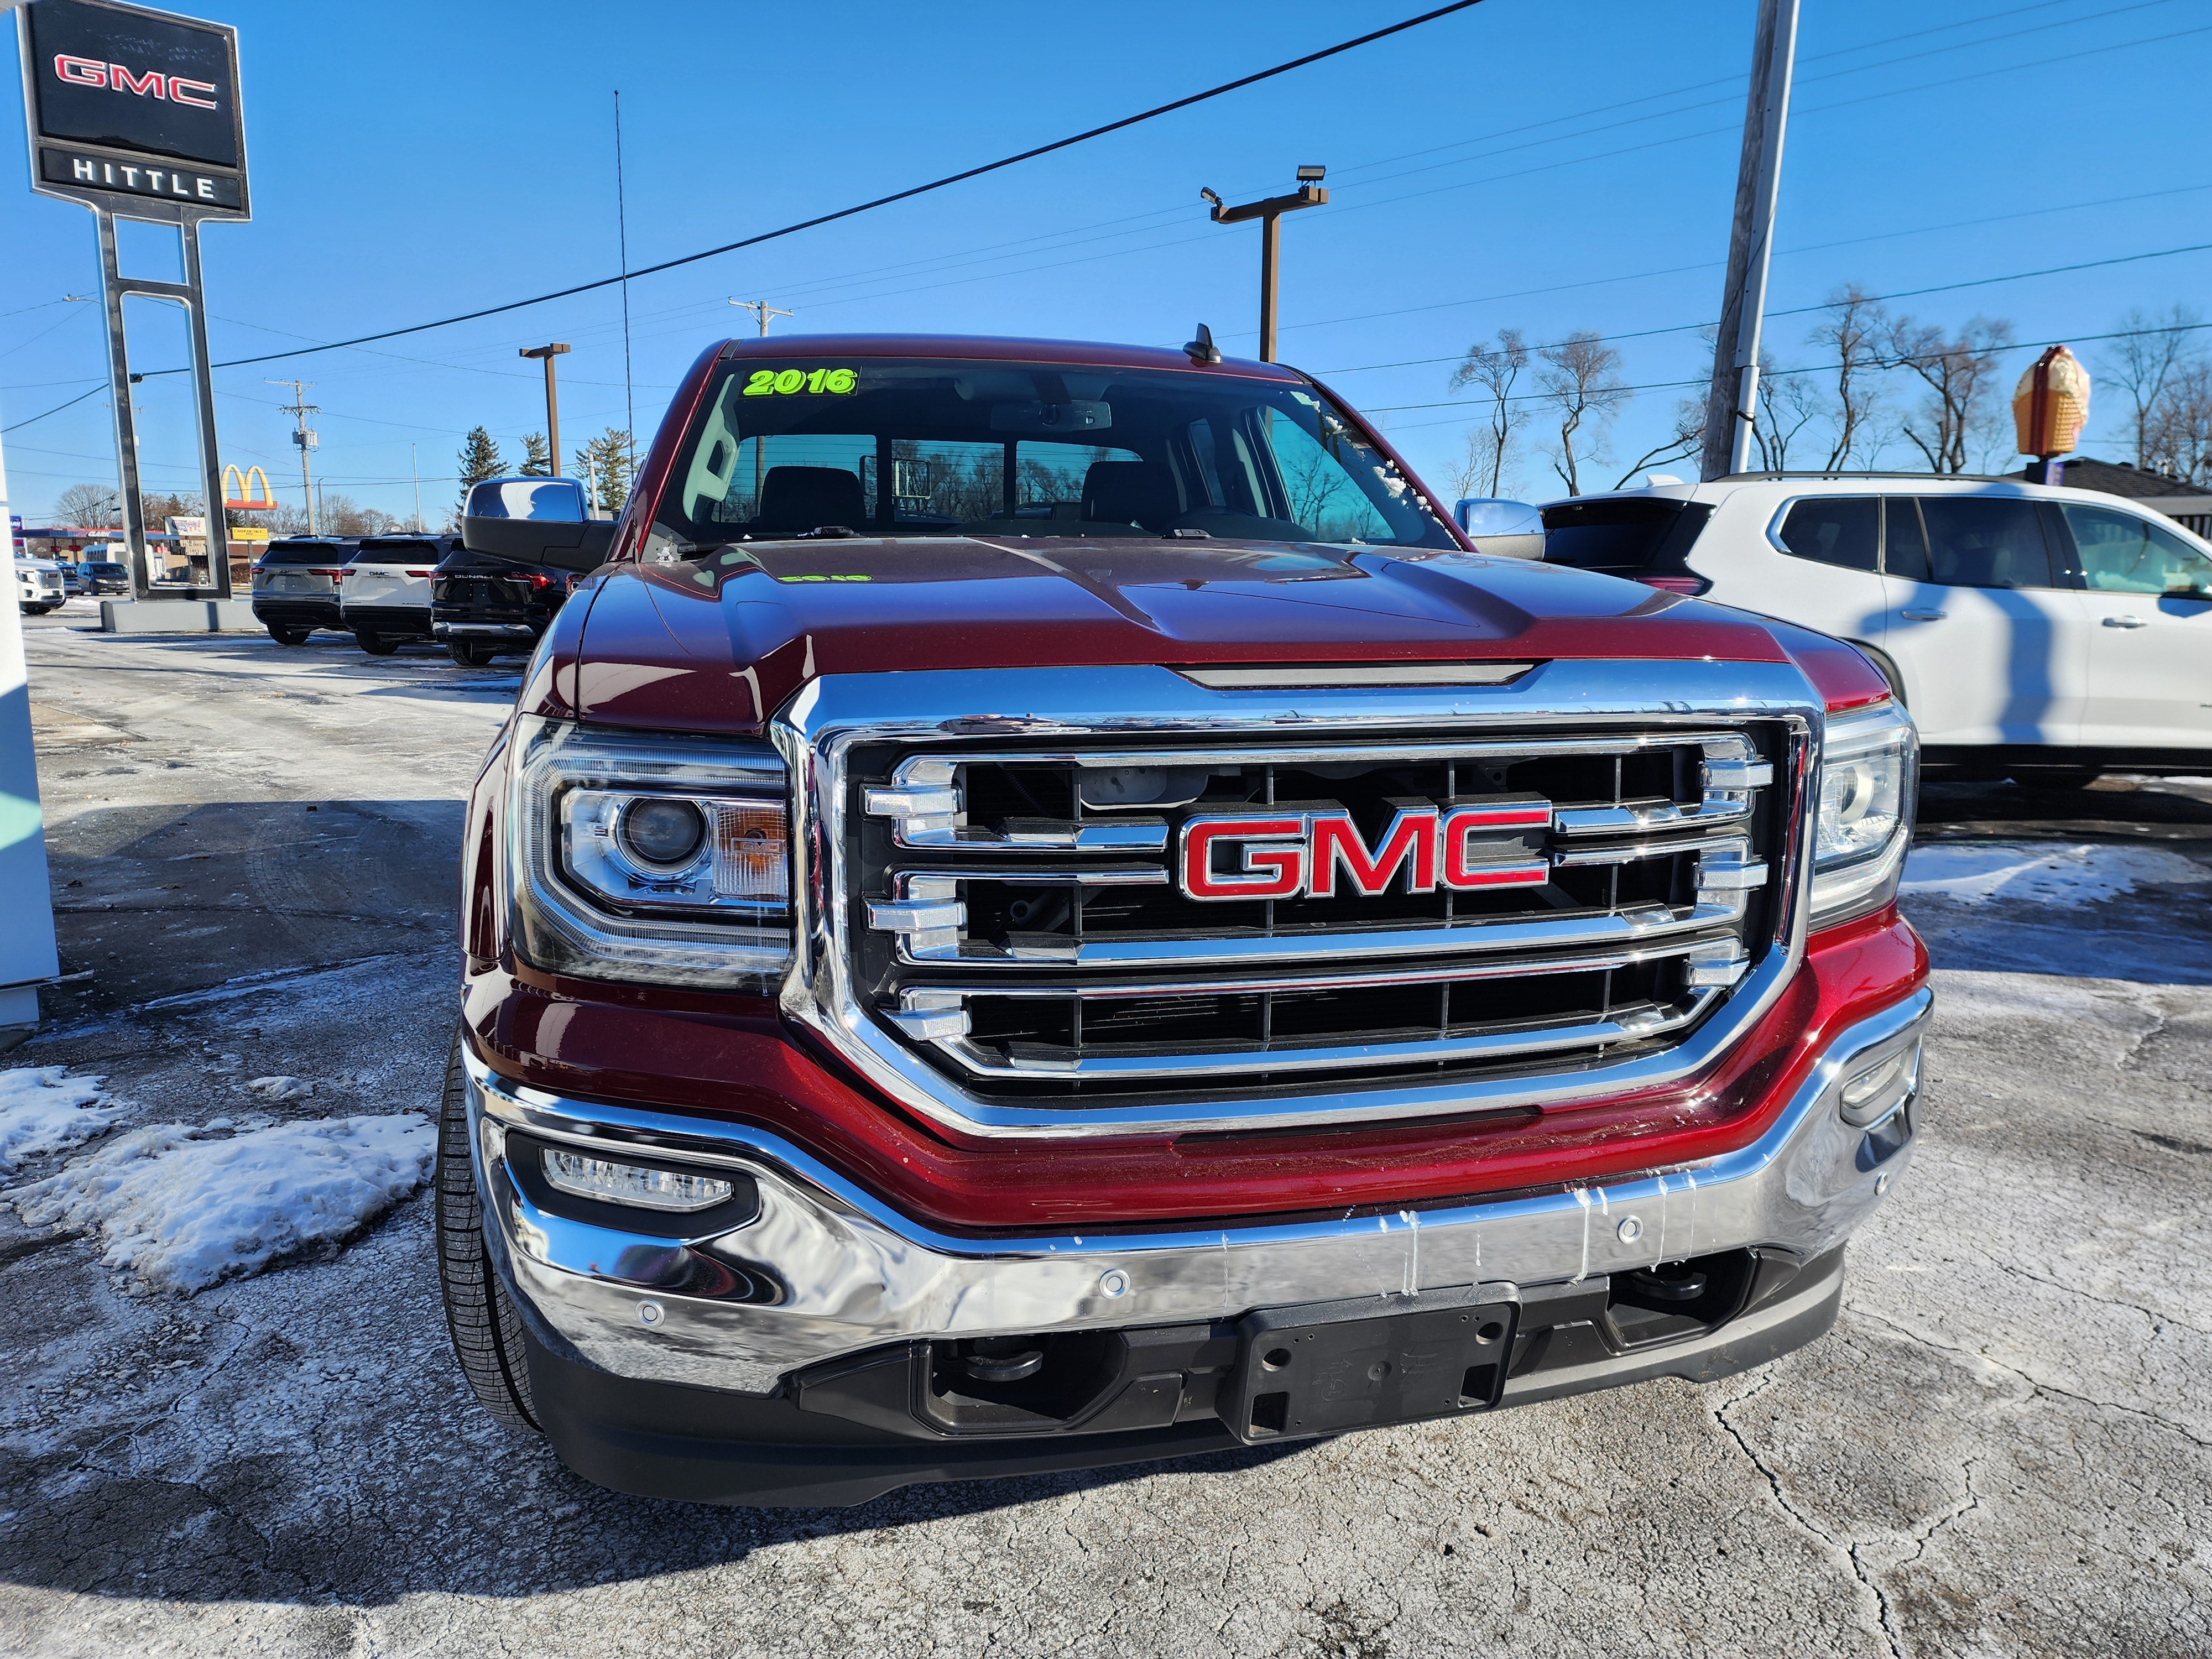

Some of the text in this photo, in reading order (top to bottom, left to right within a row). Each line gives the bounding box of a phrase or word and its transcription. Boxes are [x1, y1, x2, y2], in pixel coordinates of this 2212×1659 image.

[54, 53, 216, 111] GMC
[73, 158, 214, 199] HITTLE
[743, 368, 858, 396] 2016
[740, 842, 780, 853] GMC
[1179, 800, 1552, 902] GMC
